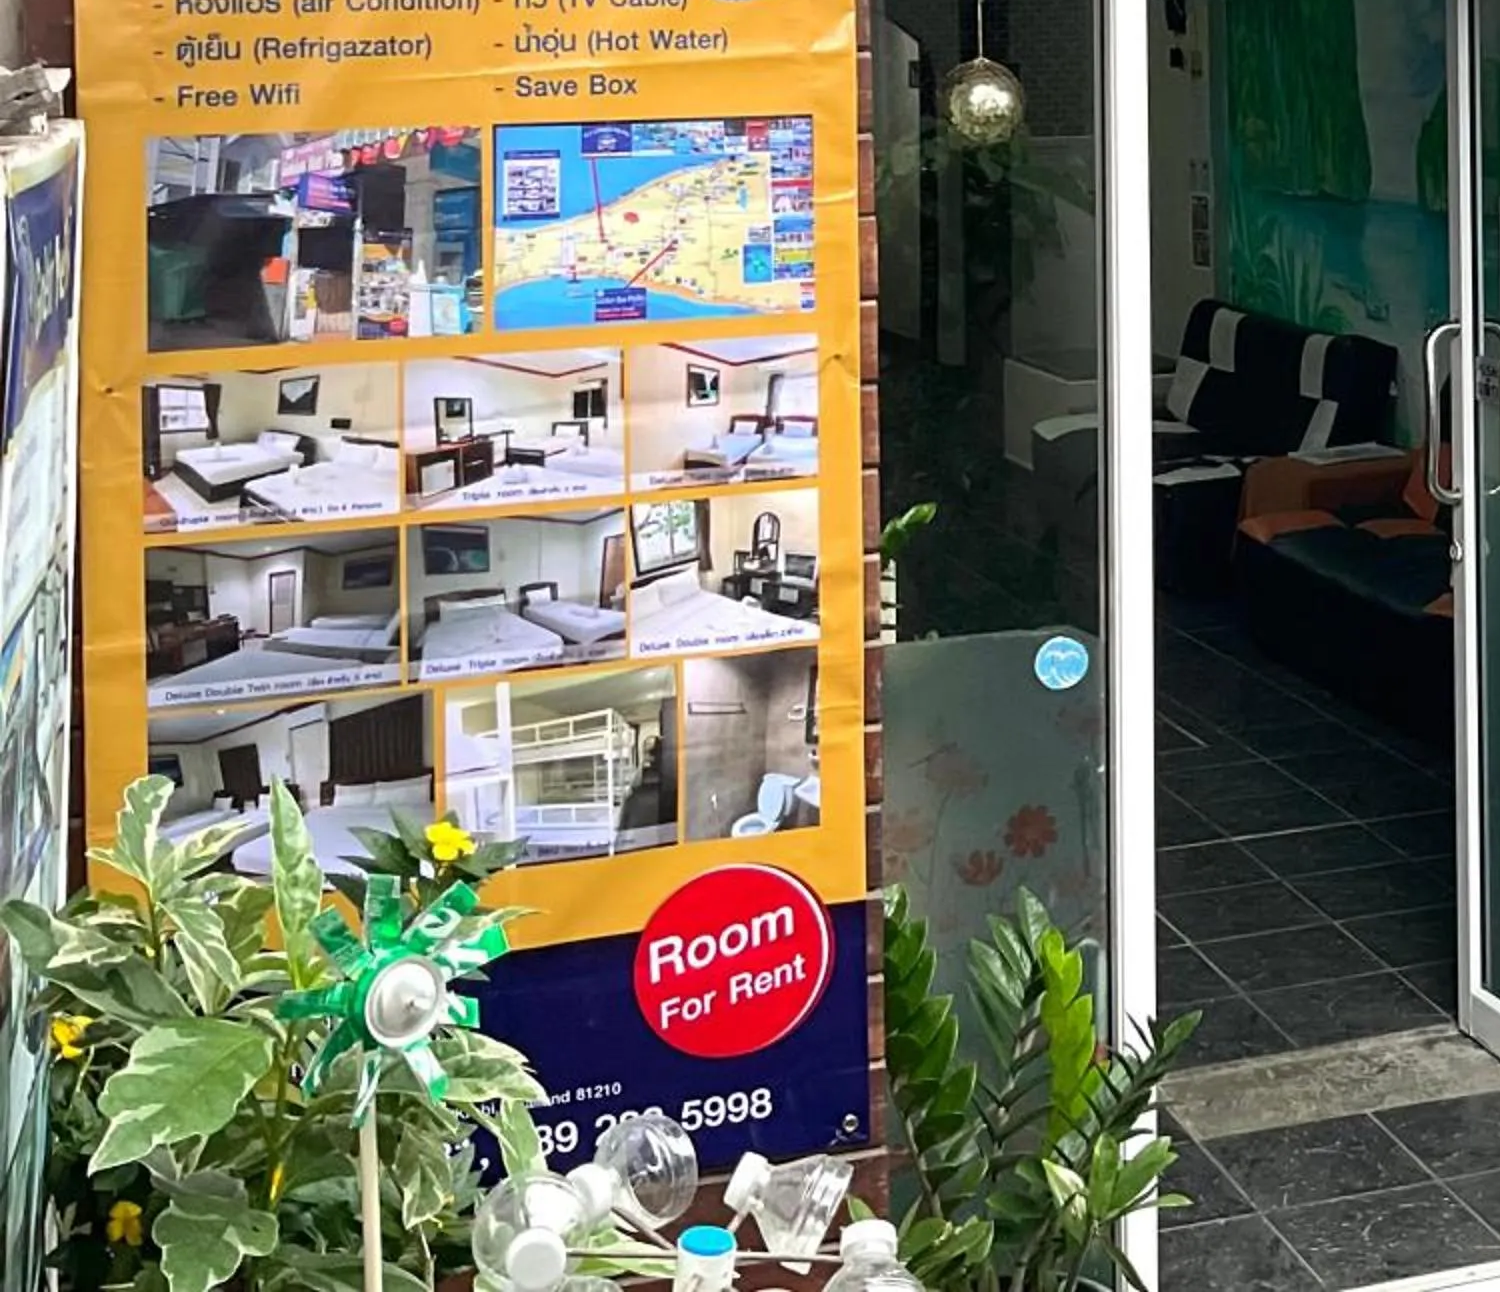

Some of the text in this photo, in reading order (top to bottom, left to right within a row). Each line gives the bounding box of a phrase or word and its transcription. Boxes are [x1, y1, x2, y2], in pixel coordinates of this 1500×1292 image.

[176, 33, 432, 68] ตู้เย็น (Refrigazator)
[515, 23, 728, 58] น้ำอุ่น (Hot Water)
[177, 83, 300, 107] Free Wifi
[515, 75, 637, 97] Save Box
[649, 905, 794, 984] Room
[660, 953, 806, 1029] For Rent
[576, 1082, 622, 1101] 81210
[681, 1087, 773, 1132] 5998
